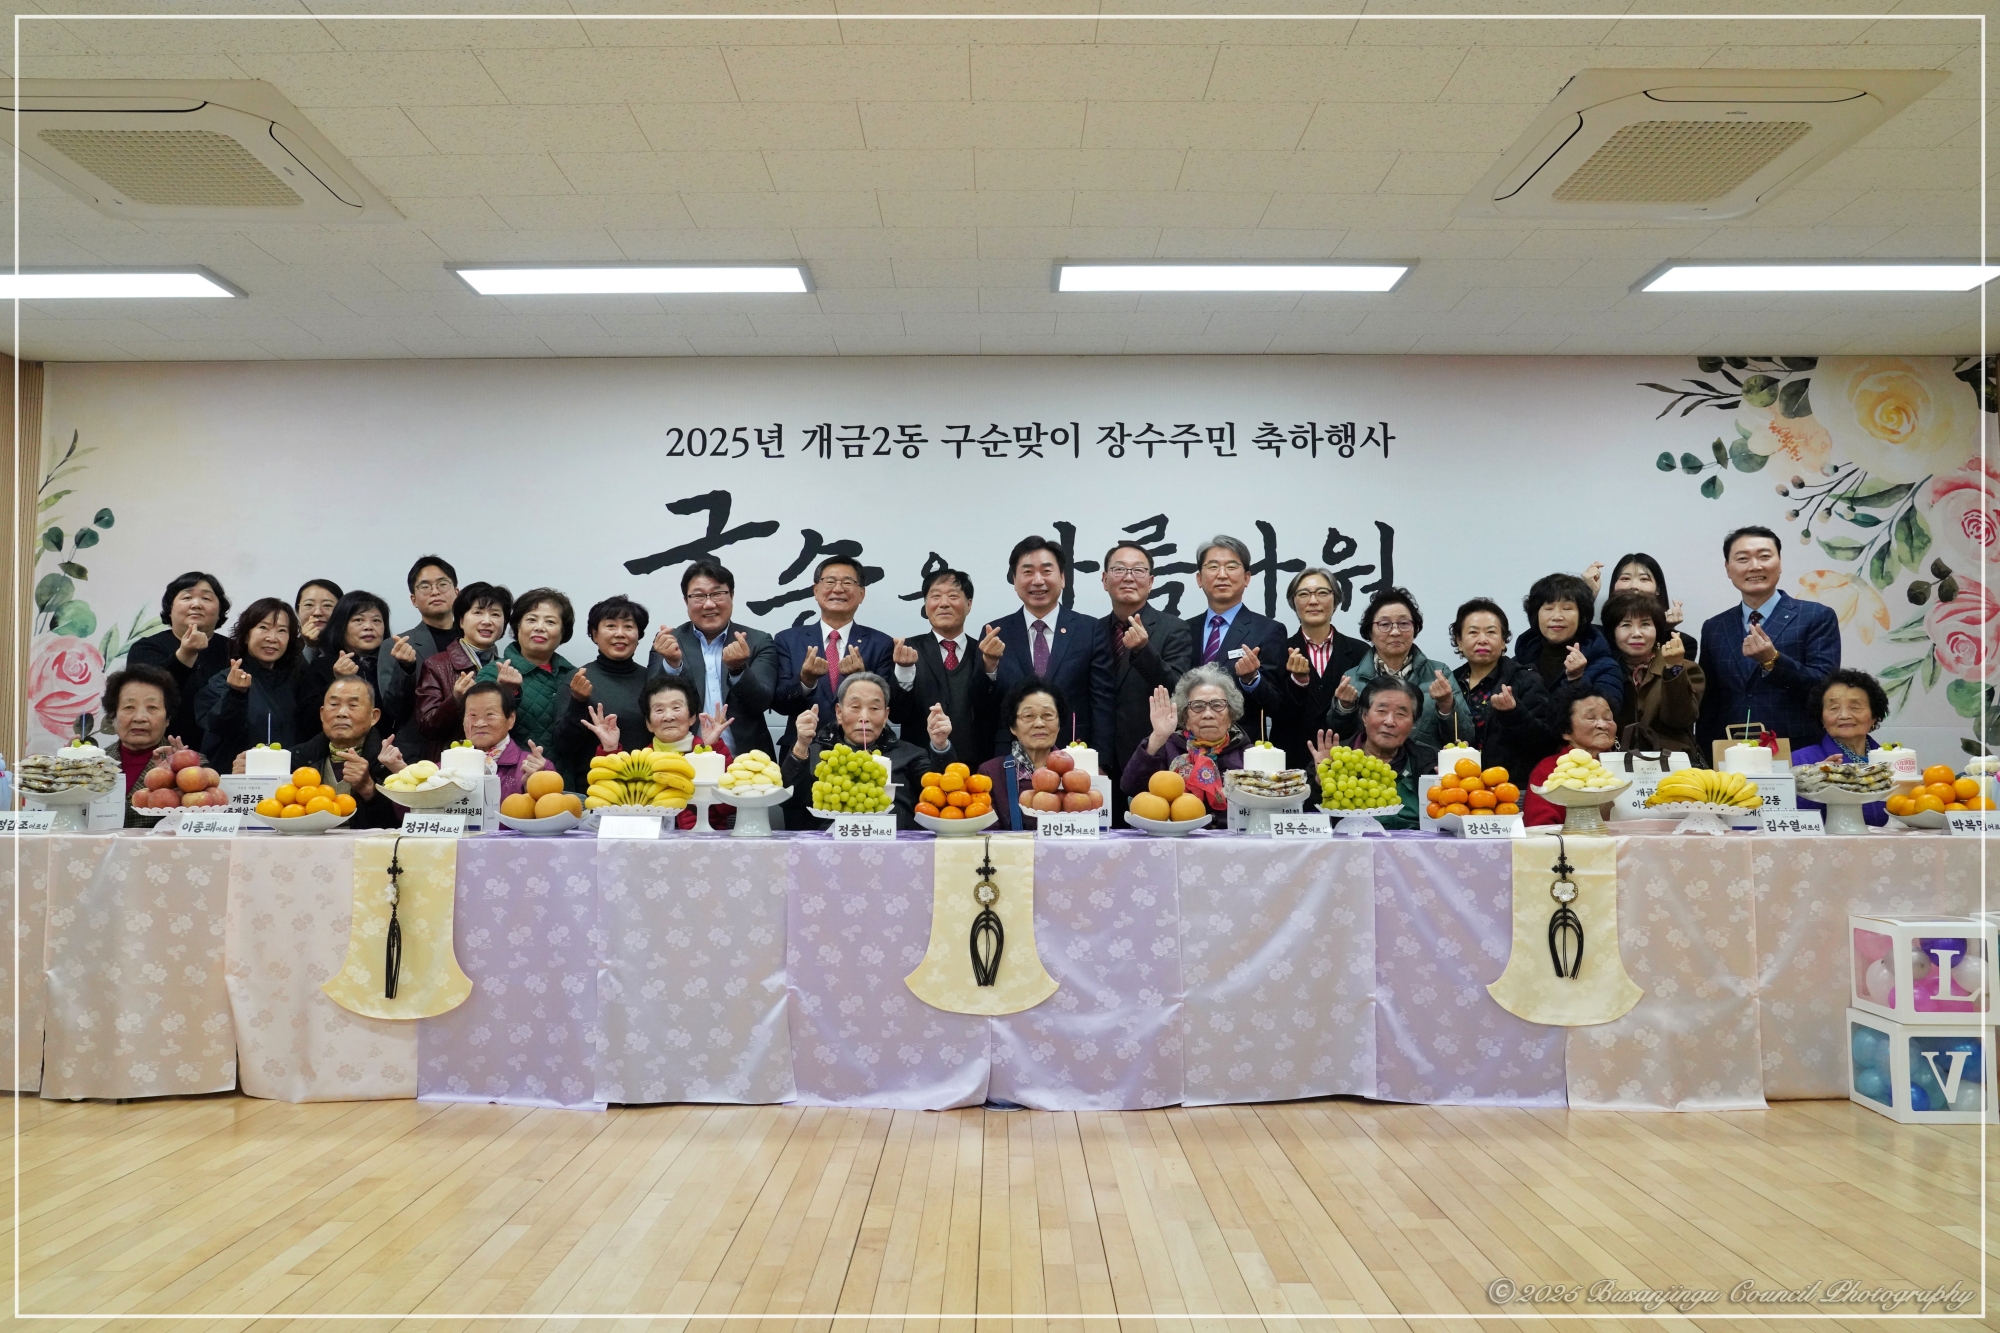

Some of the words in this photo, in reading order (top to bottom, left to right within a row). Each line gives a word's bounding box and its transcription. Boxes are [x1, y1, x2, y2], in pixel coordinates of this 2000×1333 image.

[665, 422, 785, 459] 2025년
[801, 422, 929, 460] 개금2동
[940, 421, 1080, 460] 구순맞이
[1096, 421, 1238, 459] 장수주민
[1251, 421, 1397, 459] 축하행사
[1635, 787, 1658, 798] 개금
[1759, 795, 1782, 806] 2동
[223, 806, 257, 816] 르게살기
[1930, 948, 1982, 1002] L
[1921, 1051, 1973, 1104] V
